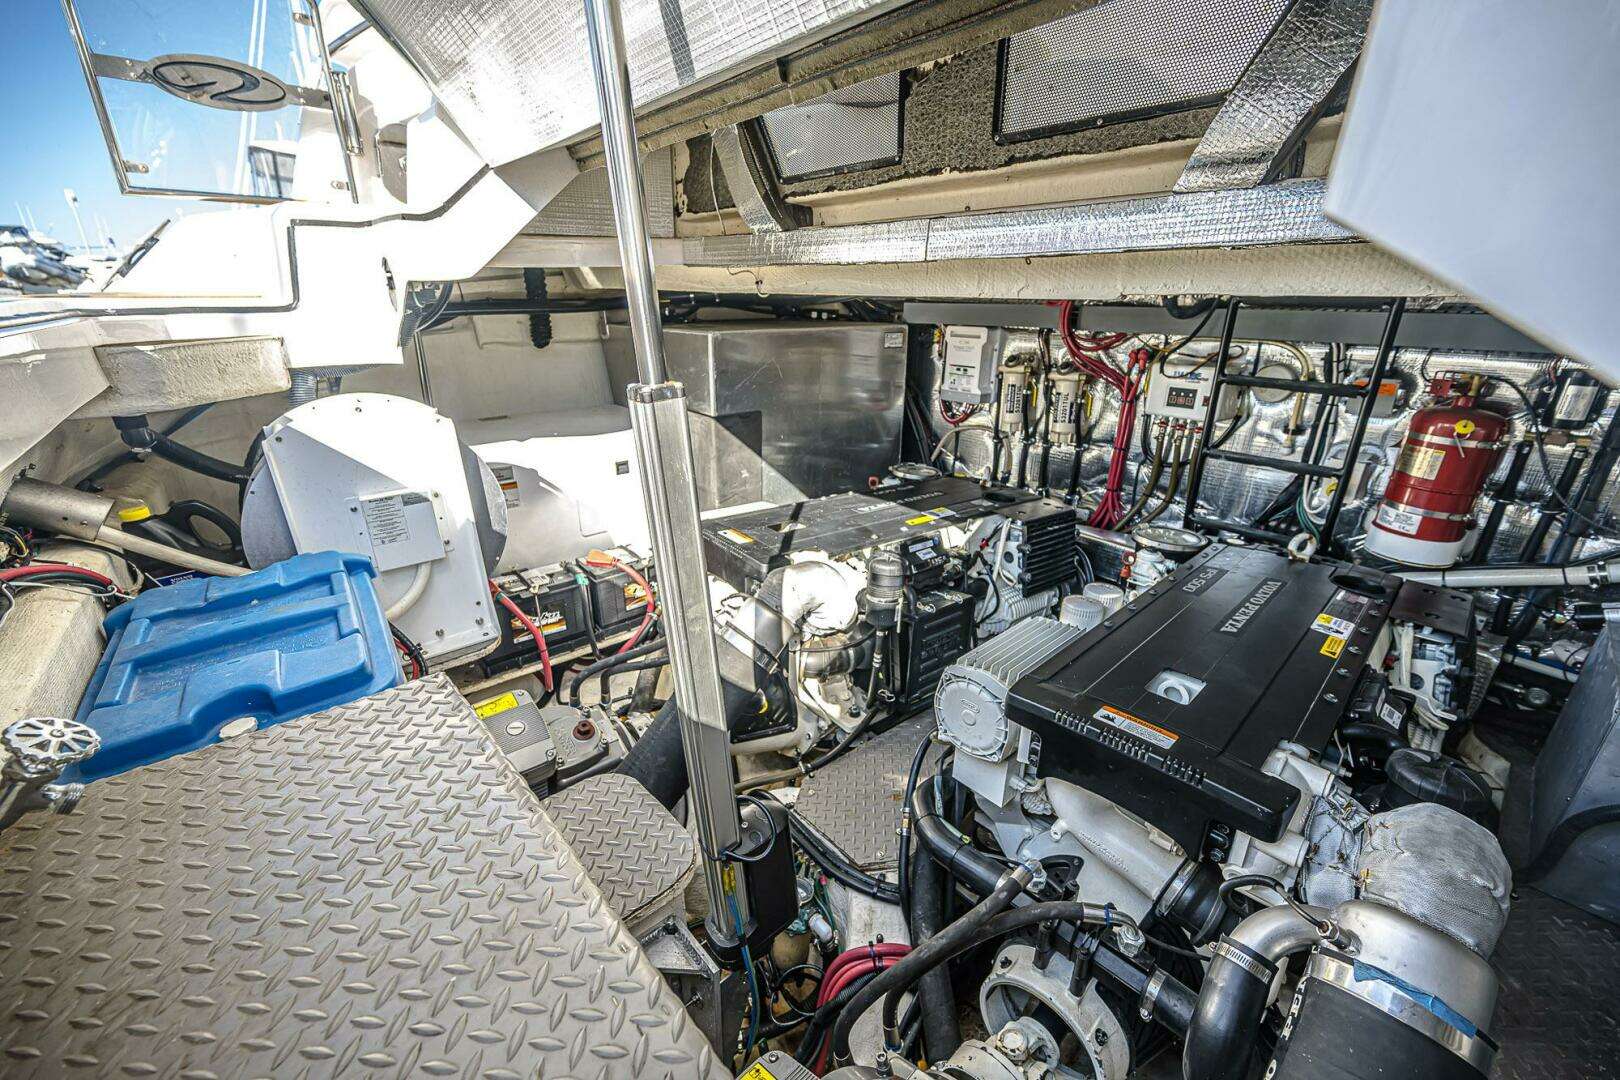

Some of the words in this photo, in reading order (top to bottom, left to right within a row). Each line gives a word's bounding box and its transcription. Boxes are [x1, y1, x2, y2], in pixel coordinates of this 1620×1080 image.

[1182, 578, 1206, 593] 500
[1251, 581, 1282, 604] VOLVO
[1220, 602, 1260, 633] PENTA
